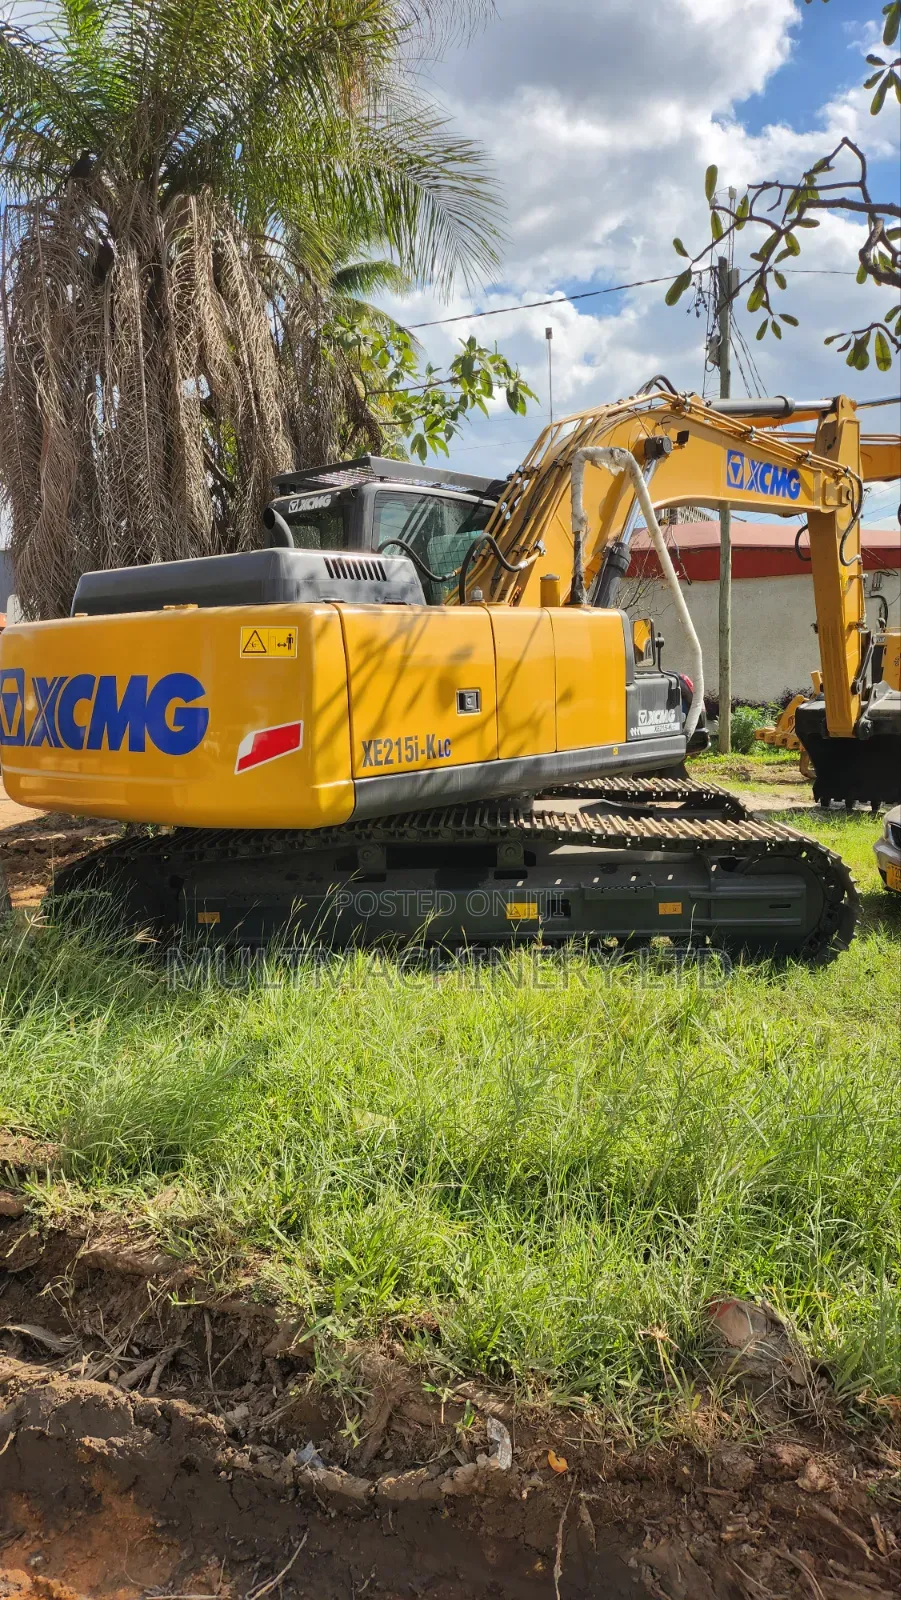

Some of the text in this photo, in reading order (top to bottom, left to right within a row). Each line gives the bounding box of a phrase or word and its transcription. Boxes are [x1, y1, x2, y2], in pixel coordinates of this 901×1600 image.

[745, 459, 801, 500] XCMG
[298, 495, 331, 511] XCMG
[26, 673, 209, 756] XCMG
[647, 709, 675, 725] XCMG
